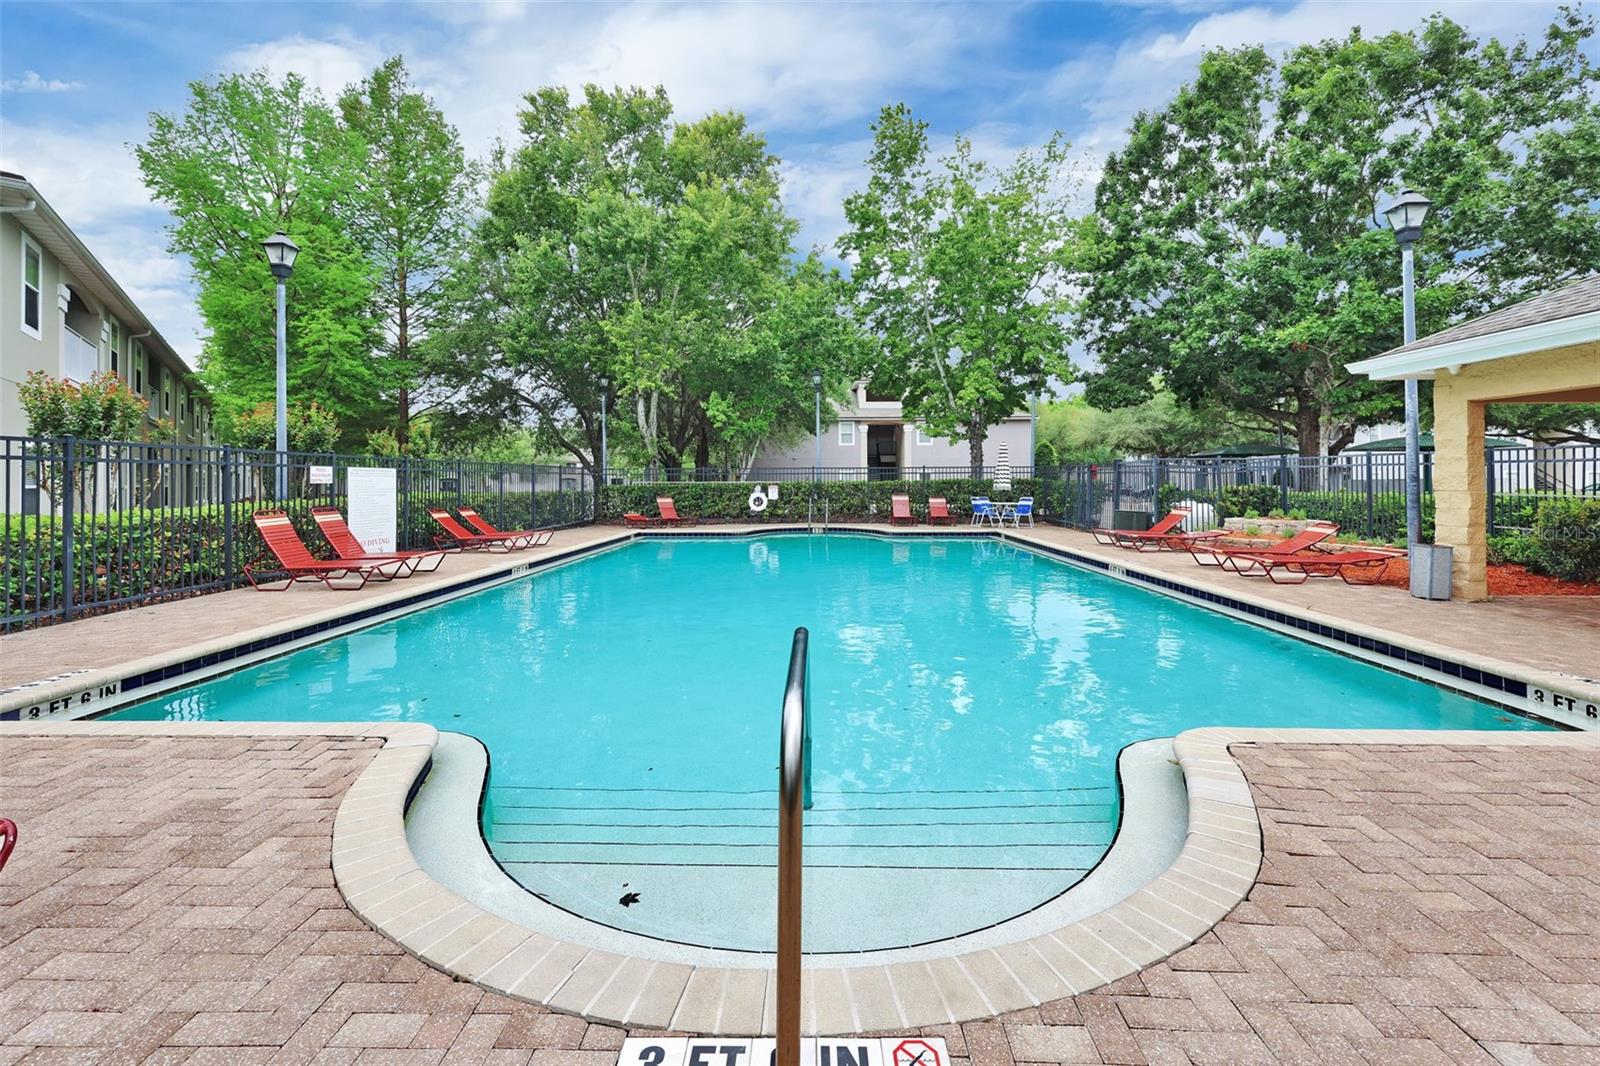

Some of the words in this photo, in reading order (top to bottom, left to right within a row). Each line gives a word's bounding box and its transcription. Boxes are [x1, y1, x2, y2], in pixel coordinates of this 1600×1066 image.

[367, 535, 390, 547] DIVING
[28, 706, 41, 720] 3
[49, 696, 73, 714] FT
[80, 692, 92, 704] 6
[99, 684, 117, 699] IN
[1534, 689, 1545, 703] 3
[1553, 693, 1577, 712] FT
[1586, 704, 1598, 719] 6
[689, 1045, 747, 1066] FT
[820, 1045, 870, 1066] IN
